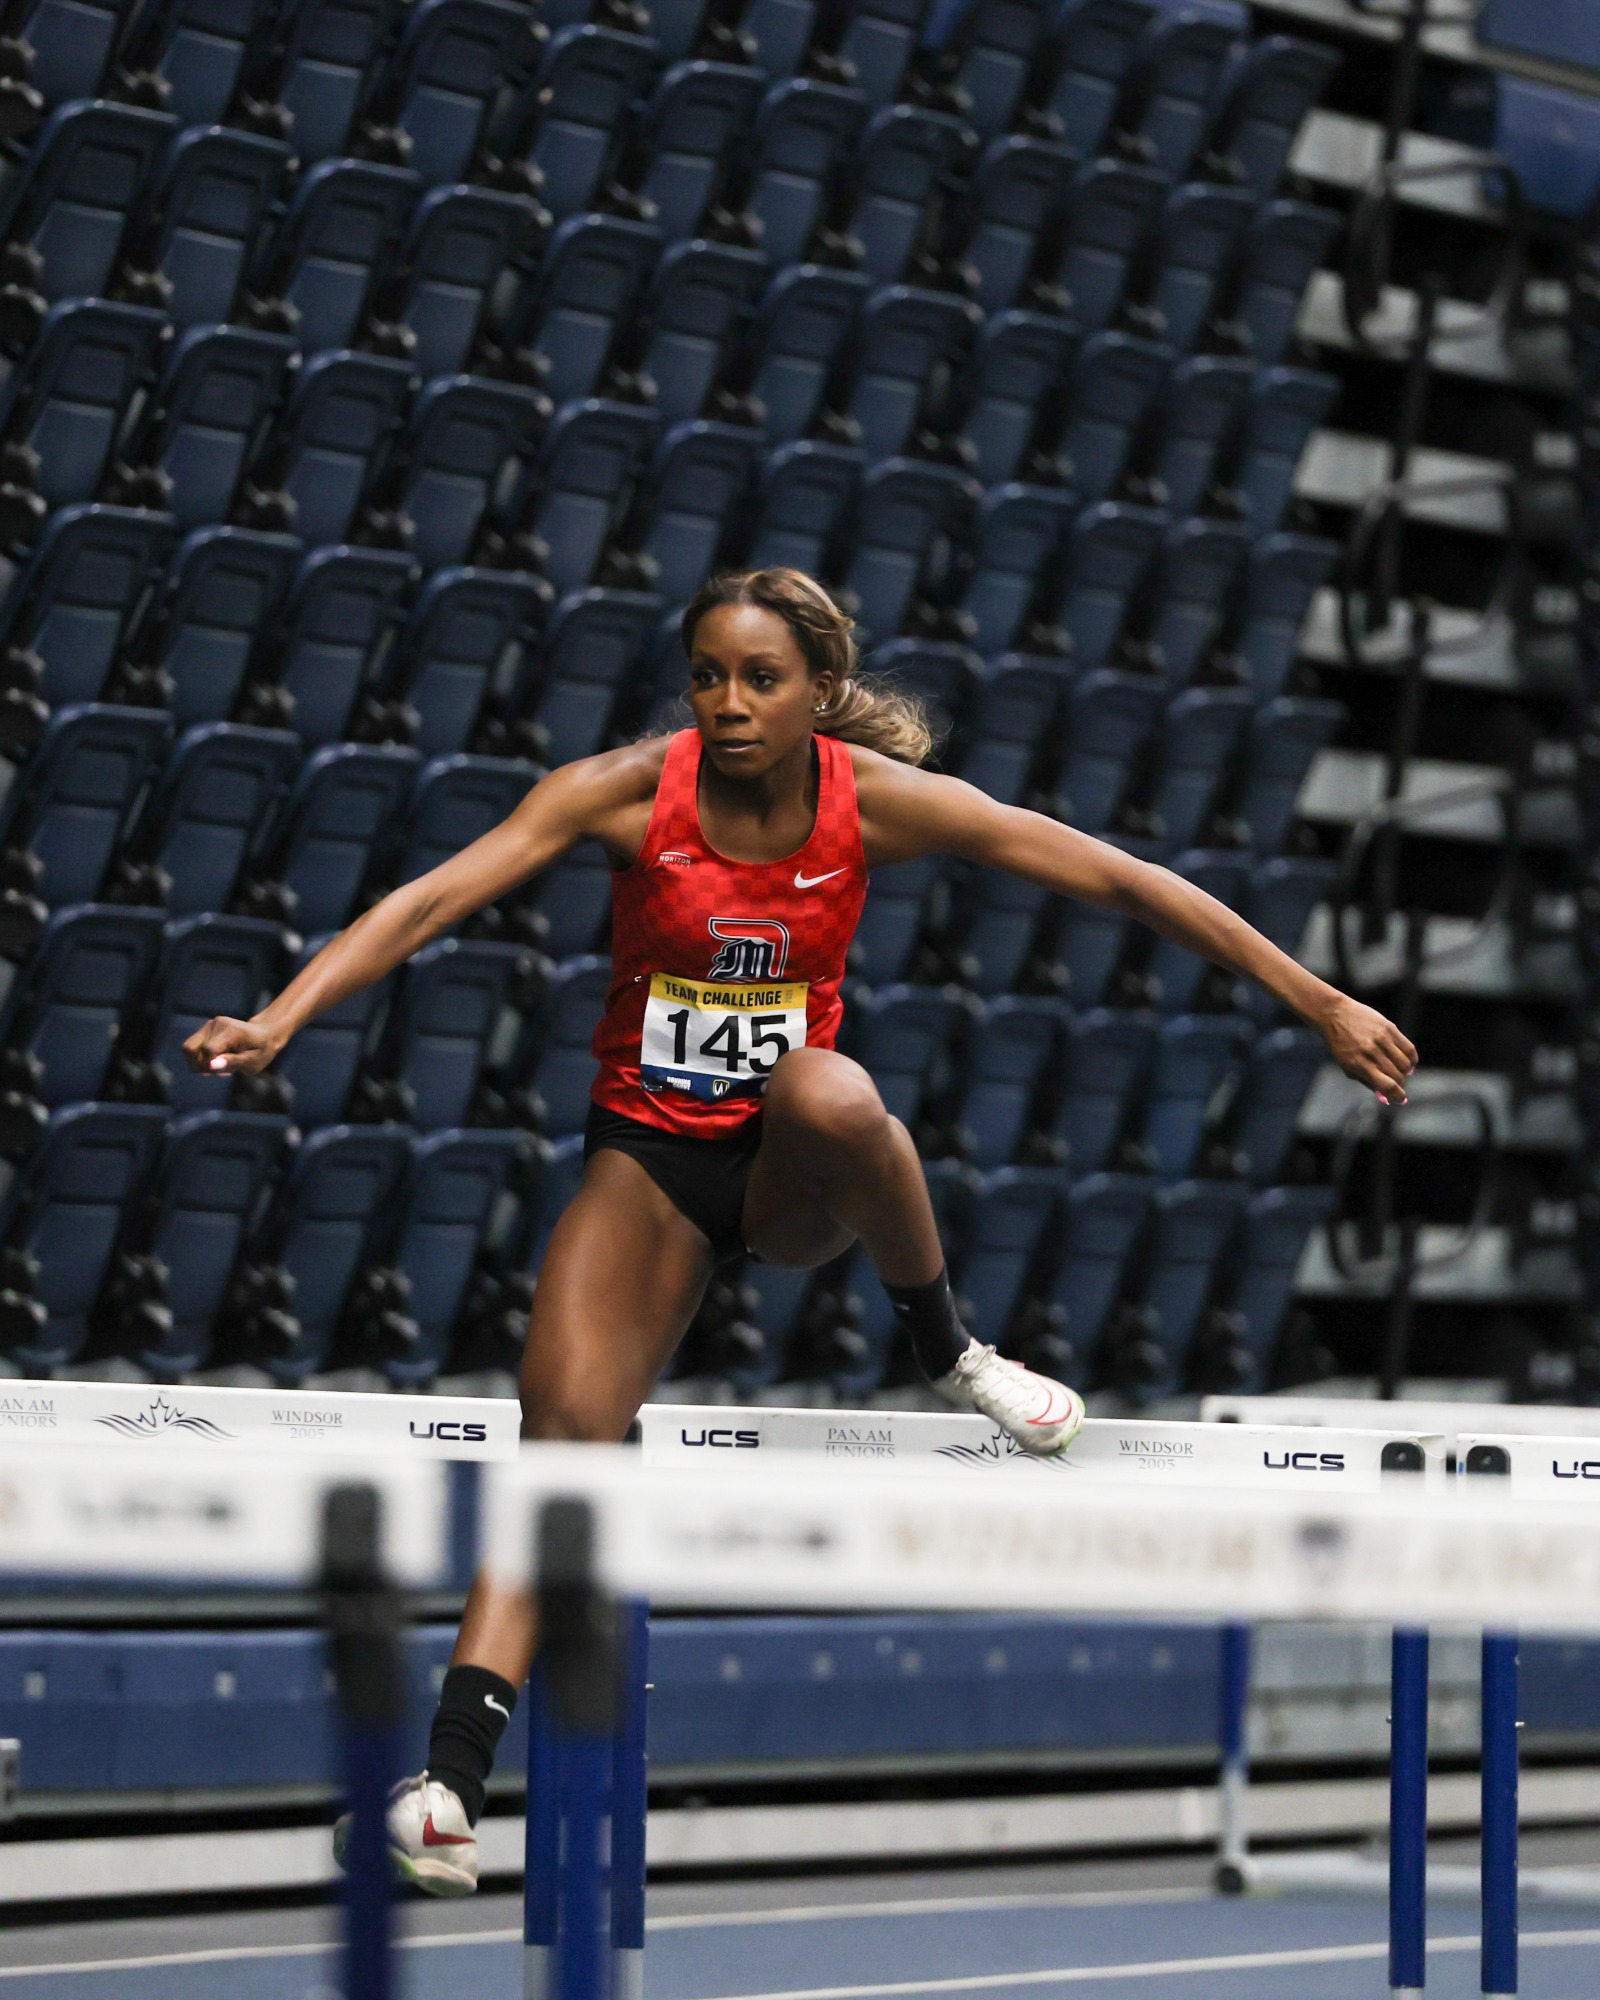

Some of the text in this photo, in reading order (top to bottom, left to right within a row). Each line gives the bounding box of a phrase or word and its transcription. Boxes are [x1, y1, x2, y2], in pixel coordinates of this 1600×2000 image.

[664, 981, 782, 1007] TEAM CHALLENGE
[667, 1009, 790, 1074] 145
[0, 1398, 54, 1412] AN AM
[271, 1409, 343, 1425] WINDSOR
[289, 1426, 326, 1440] 2005
[409, 1420, 487, 1442] UCS
[681, 1429, 760, 1449] UCS
[827, 1427, 892, 1442] PAN AM
[826, 1444, 896, 1459] JUNIORS
[1118, 1439, 1194, 1455] WINDSOR
[1137, 1456, 1176, 1471] 2005
[1263, 1451, 1345, 1472] UCS
[1552, 1460, 1600, 1480] UC
